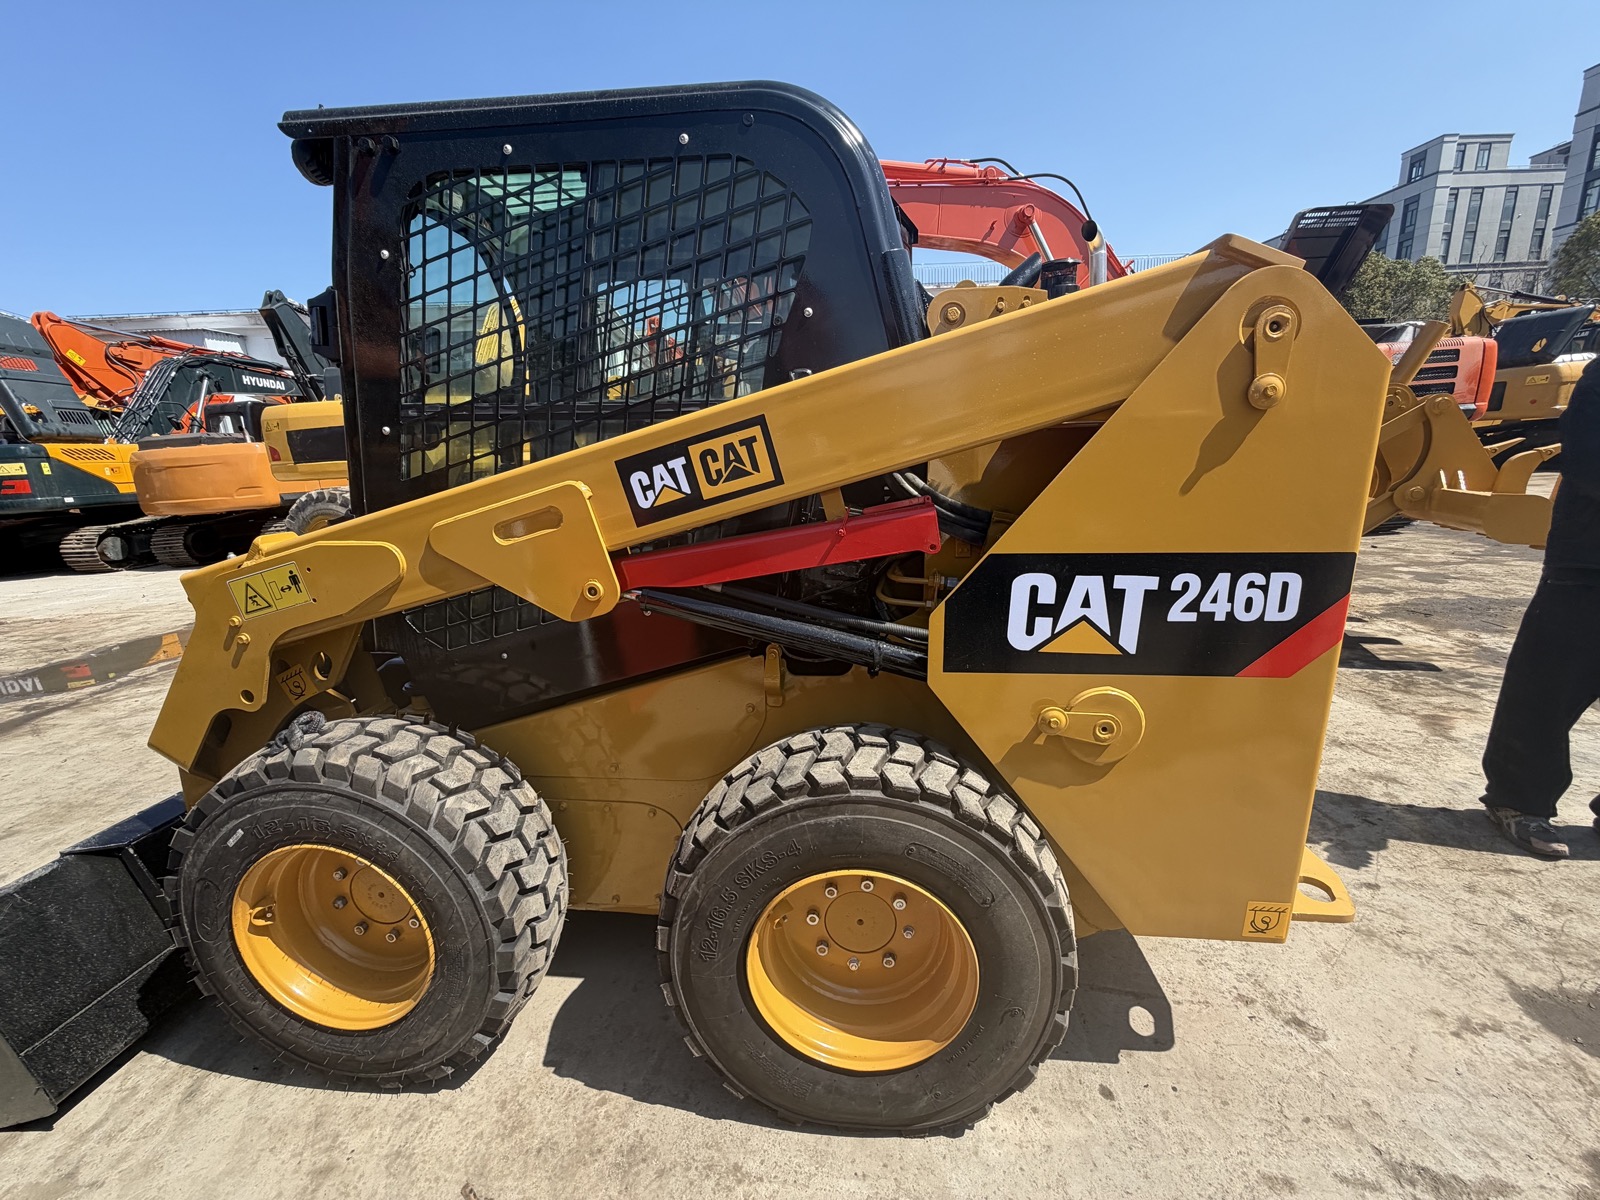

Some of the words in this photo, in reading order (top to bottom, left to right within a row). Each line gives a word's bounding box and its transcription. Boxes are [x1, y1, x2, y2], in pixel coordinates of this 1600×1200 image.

[242, 375, 285, 390] HYUNDAI
[630, 456, 691, 509] CAT
[699, 435, 760, 487] CAT
[1007, 573, 1160, 655] CAT
[1167, 572, 1303, 622] 246D
[700, 886, 739, 961] 12-16.5
[734, 838, 803, 889] SKS-4
